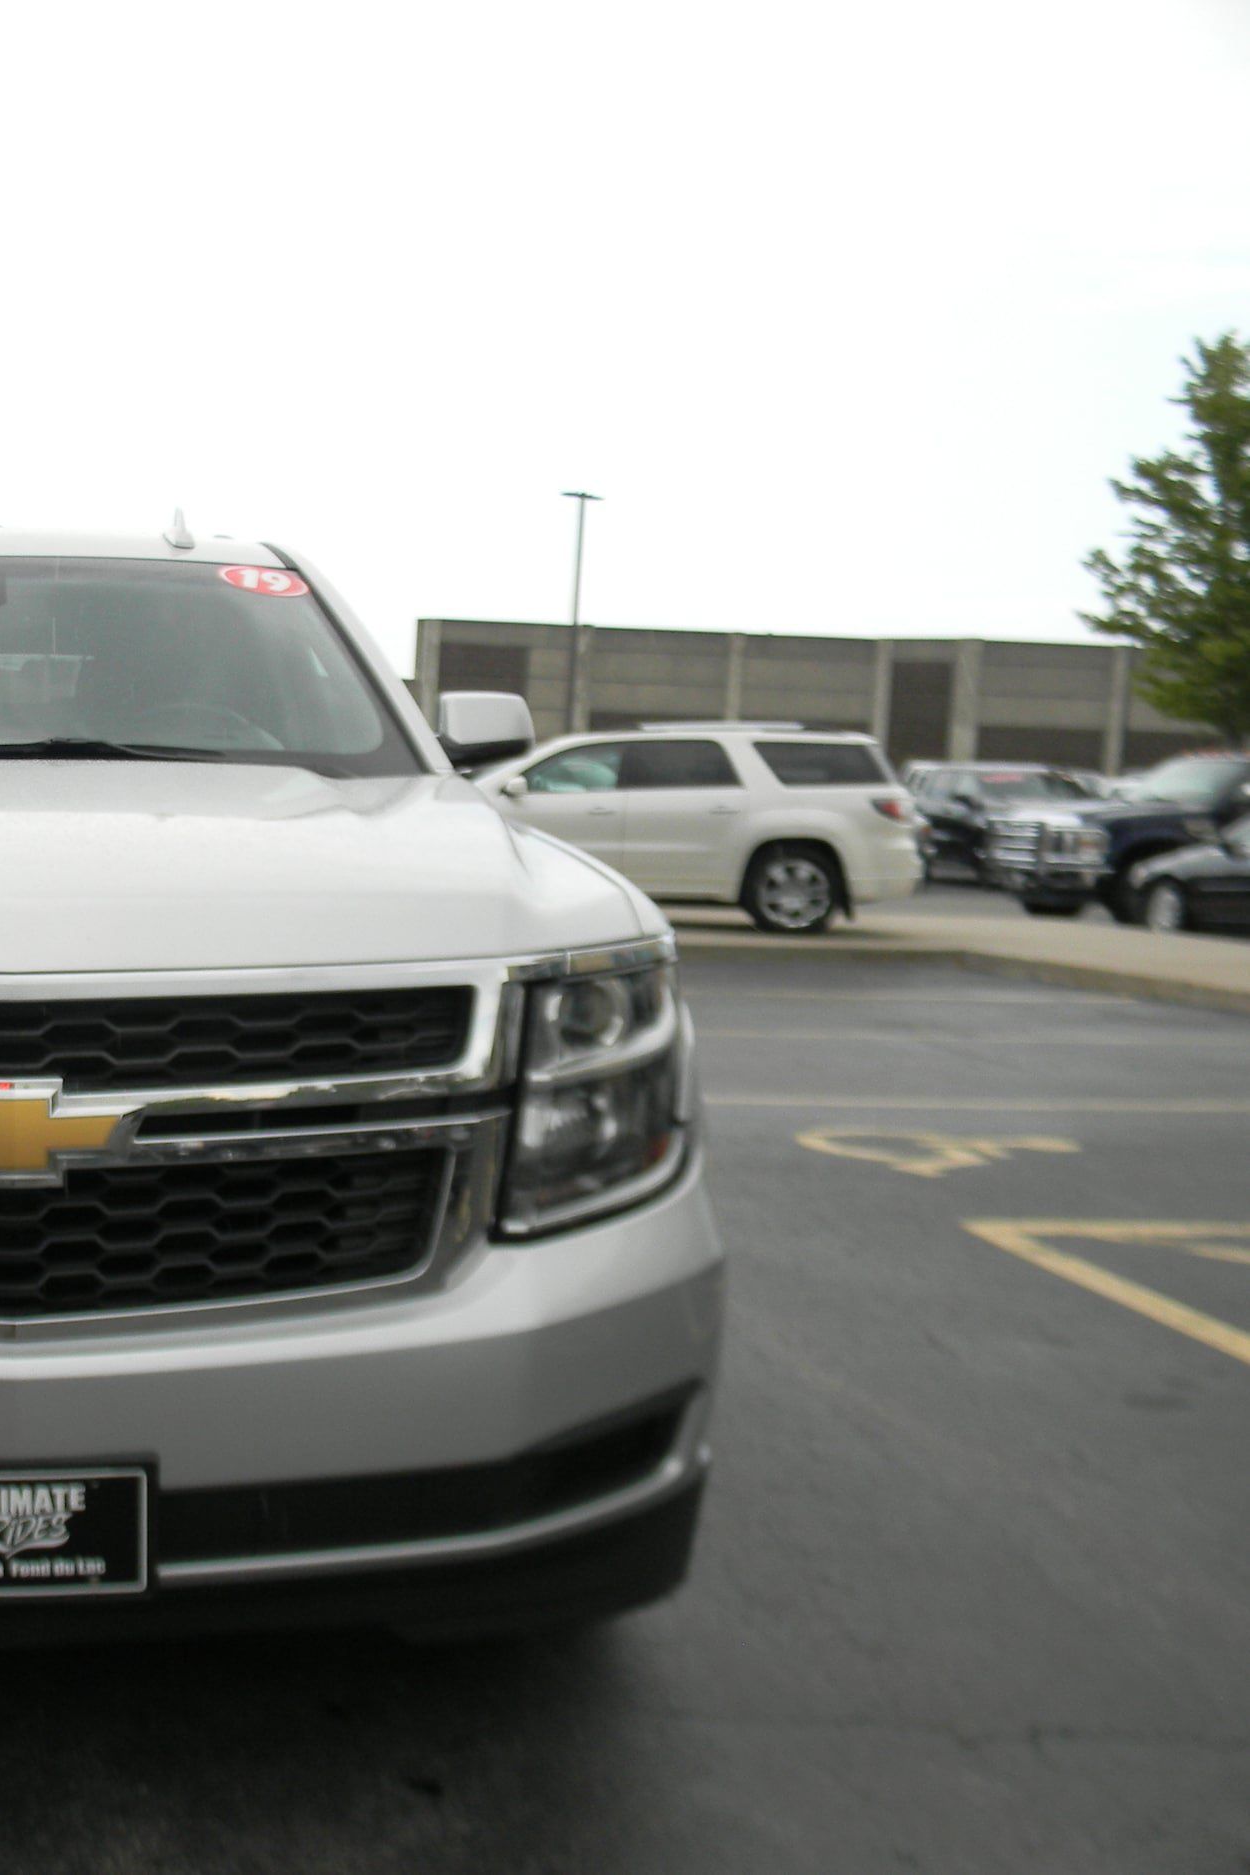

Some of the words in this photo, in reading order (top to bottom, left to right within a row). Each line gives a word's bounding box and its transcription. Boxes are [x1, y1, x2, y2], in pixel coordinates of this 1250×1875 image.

[239, 568, 292, 592] 19
[11, 1558, 51, 1577] Fond
[53, 1557, 75, 1576] du
[77, 1556, 106, 1576] Lac
